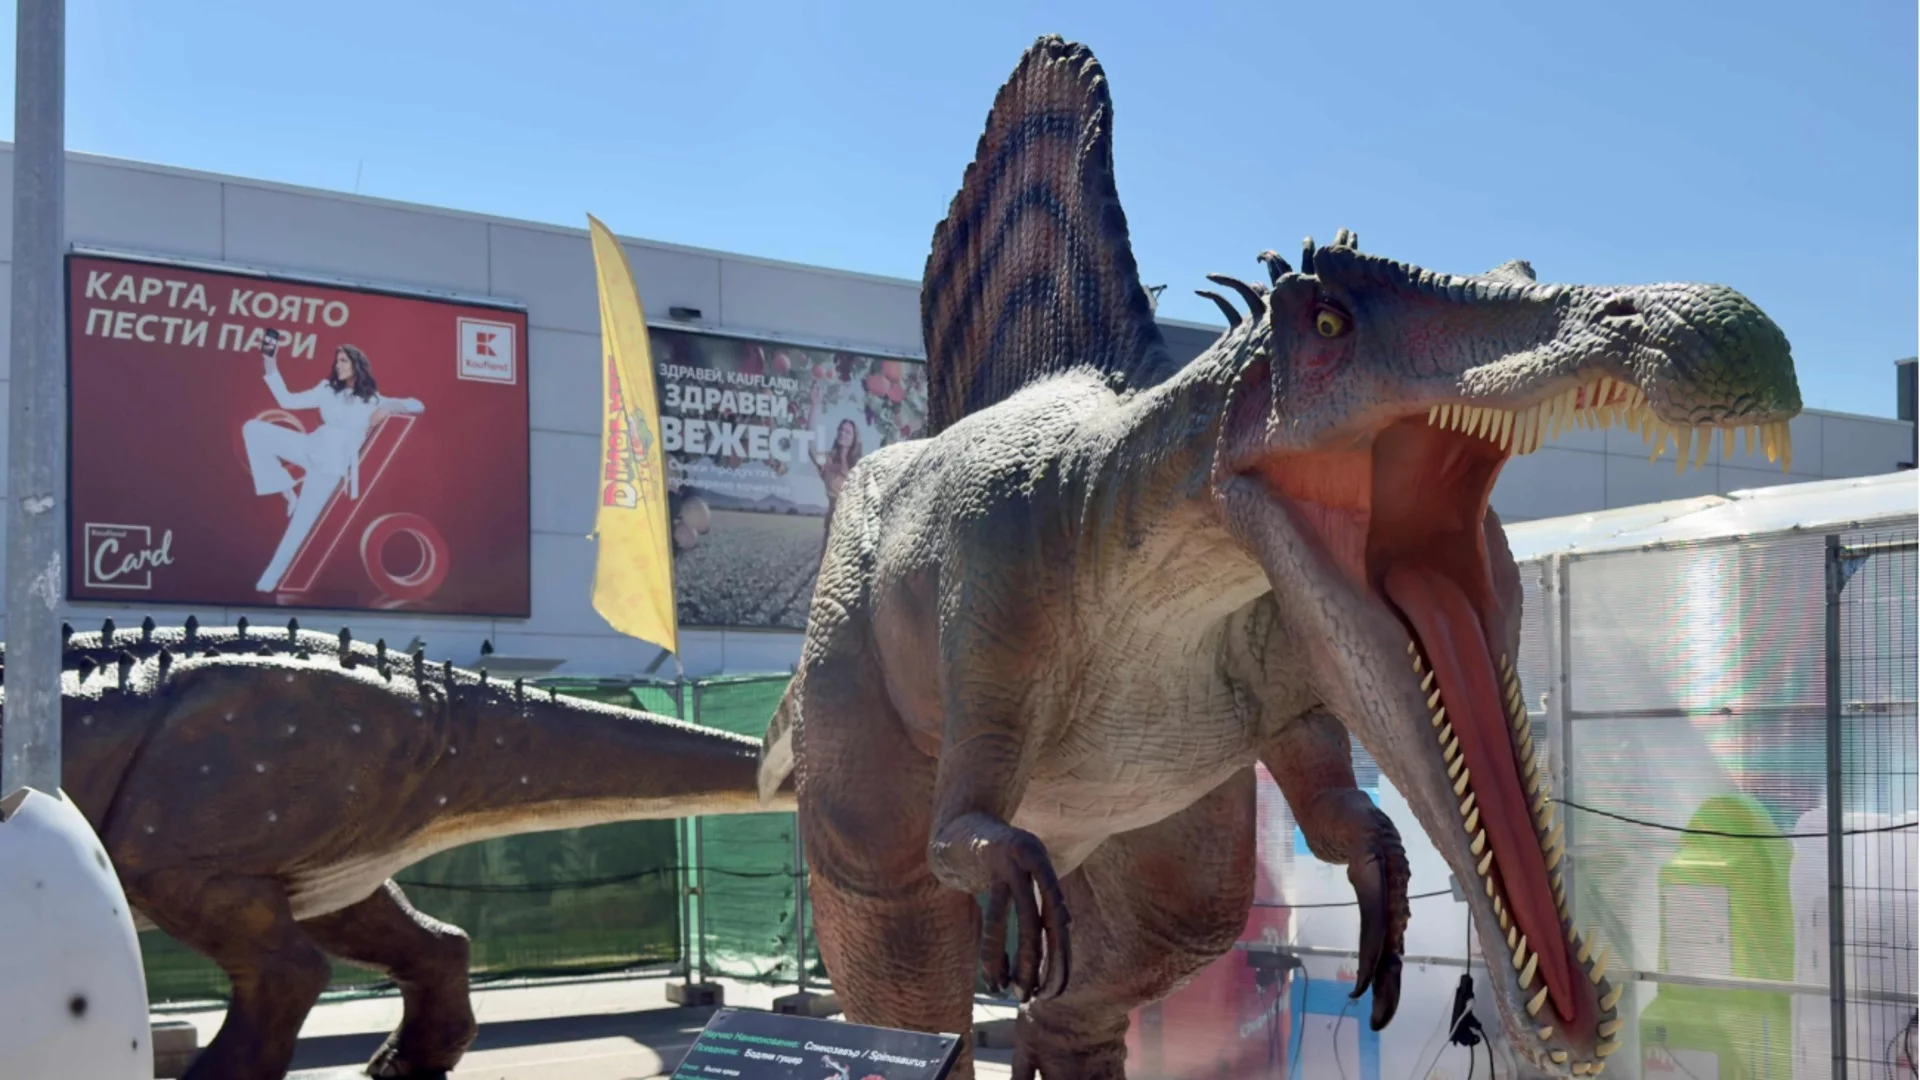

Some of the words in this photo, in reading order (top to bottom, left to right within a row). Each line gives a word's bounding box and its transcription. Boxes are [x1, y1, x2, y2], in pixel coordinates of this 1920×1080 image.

[85, 271, 216, 316] КАРТА,
[229, 289, 349, 328] КОЯТО
[85, 308, 209, 348] ПЕСТИ
[218, 323, 317, 360] ПАРИ
[659, 363, 723, 384] ЗДРАВЕЙ,
[665, 383, 793, 422] ЗДРАВЕЙ,
[660, 415, 827, 465] ВЕЖЕСТ!
[94, 528, 175, 581] Card
[868, 1049, 927, 1068] Spinosaurus
